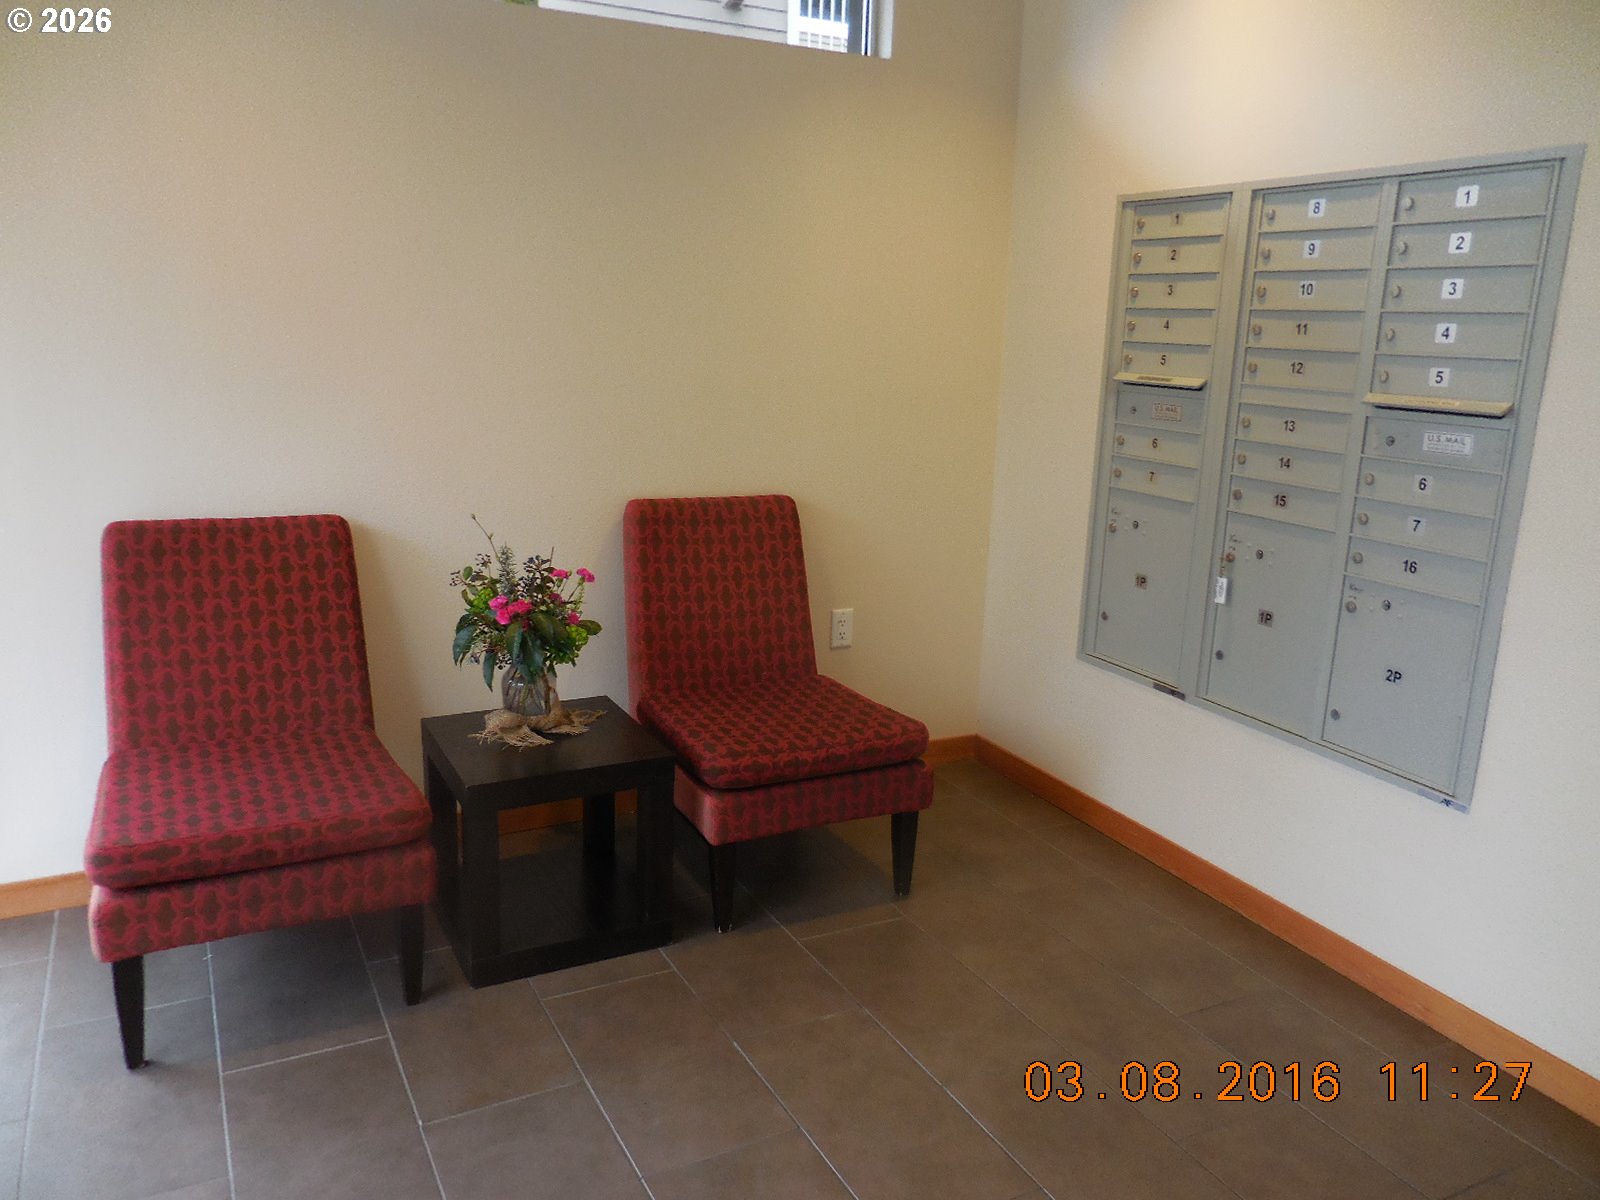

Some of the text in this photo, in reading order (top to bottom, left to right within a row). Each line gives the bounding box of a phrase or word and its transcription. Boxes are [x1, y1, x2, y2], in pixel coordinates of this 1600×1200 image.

[1464, 190, 1471, 204] 1
[1313, 201, 1321, 215] 8
[1175, 214, 1180, 225] 1
[1455, 235, 1465, 250] 2
[1170, 249, 1177, 261] 2
[1308, 243, 1316, 256] 9
[1167, 284, 1174, 296] 3
[1300, 283, 1313, 296] 10
[1448, 281, 1457, 296] 3
[1163, 319, 1170, 331] 4
[1295, 323, 1308, 335] 11
[1441, 327, 1450, 340] 4
[1160, 354, 1167, 366] 5
[1290, 362, 1304, 375] 12
[1435, 370, 1444, 384] 5
[1283, 420, 1296, 433] 13
[1152, 438, 1158, 449] 6
[1444, 434, 1467, 447] MAIL
[1278, 457, 1291, 469] 14
[1149, 471, 1155, 482] 7
[1418, 477, 1427, 491] 6
[1274, 494, 1287, 507] 15
[1413, 519, 1421, 532] 7
[1402, 559, 1417, 574] 16
[1134, 575, 1147, 587] 1P
[1259, 612, 1273, 624] 1P
[1384, 669, 1402, 683] 2P
